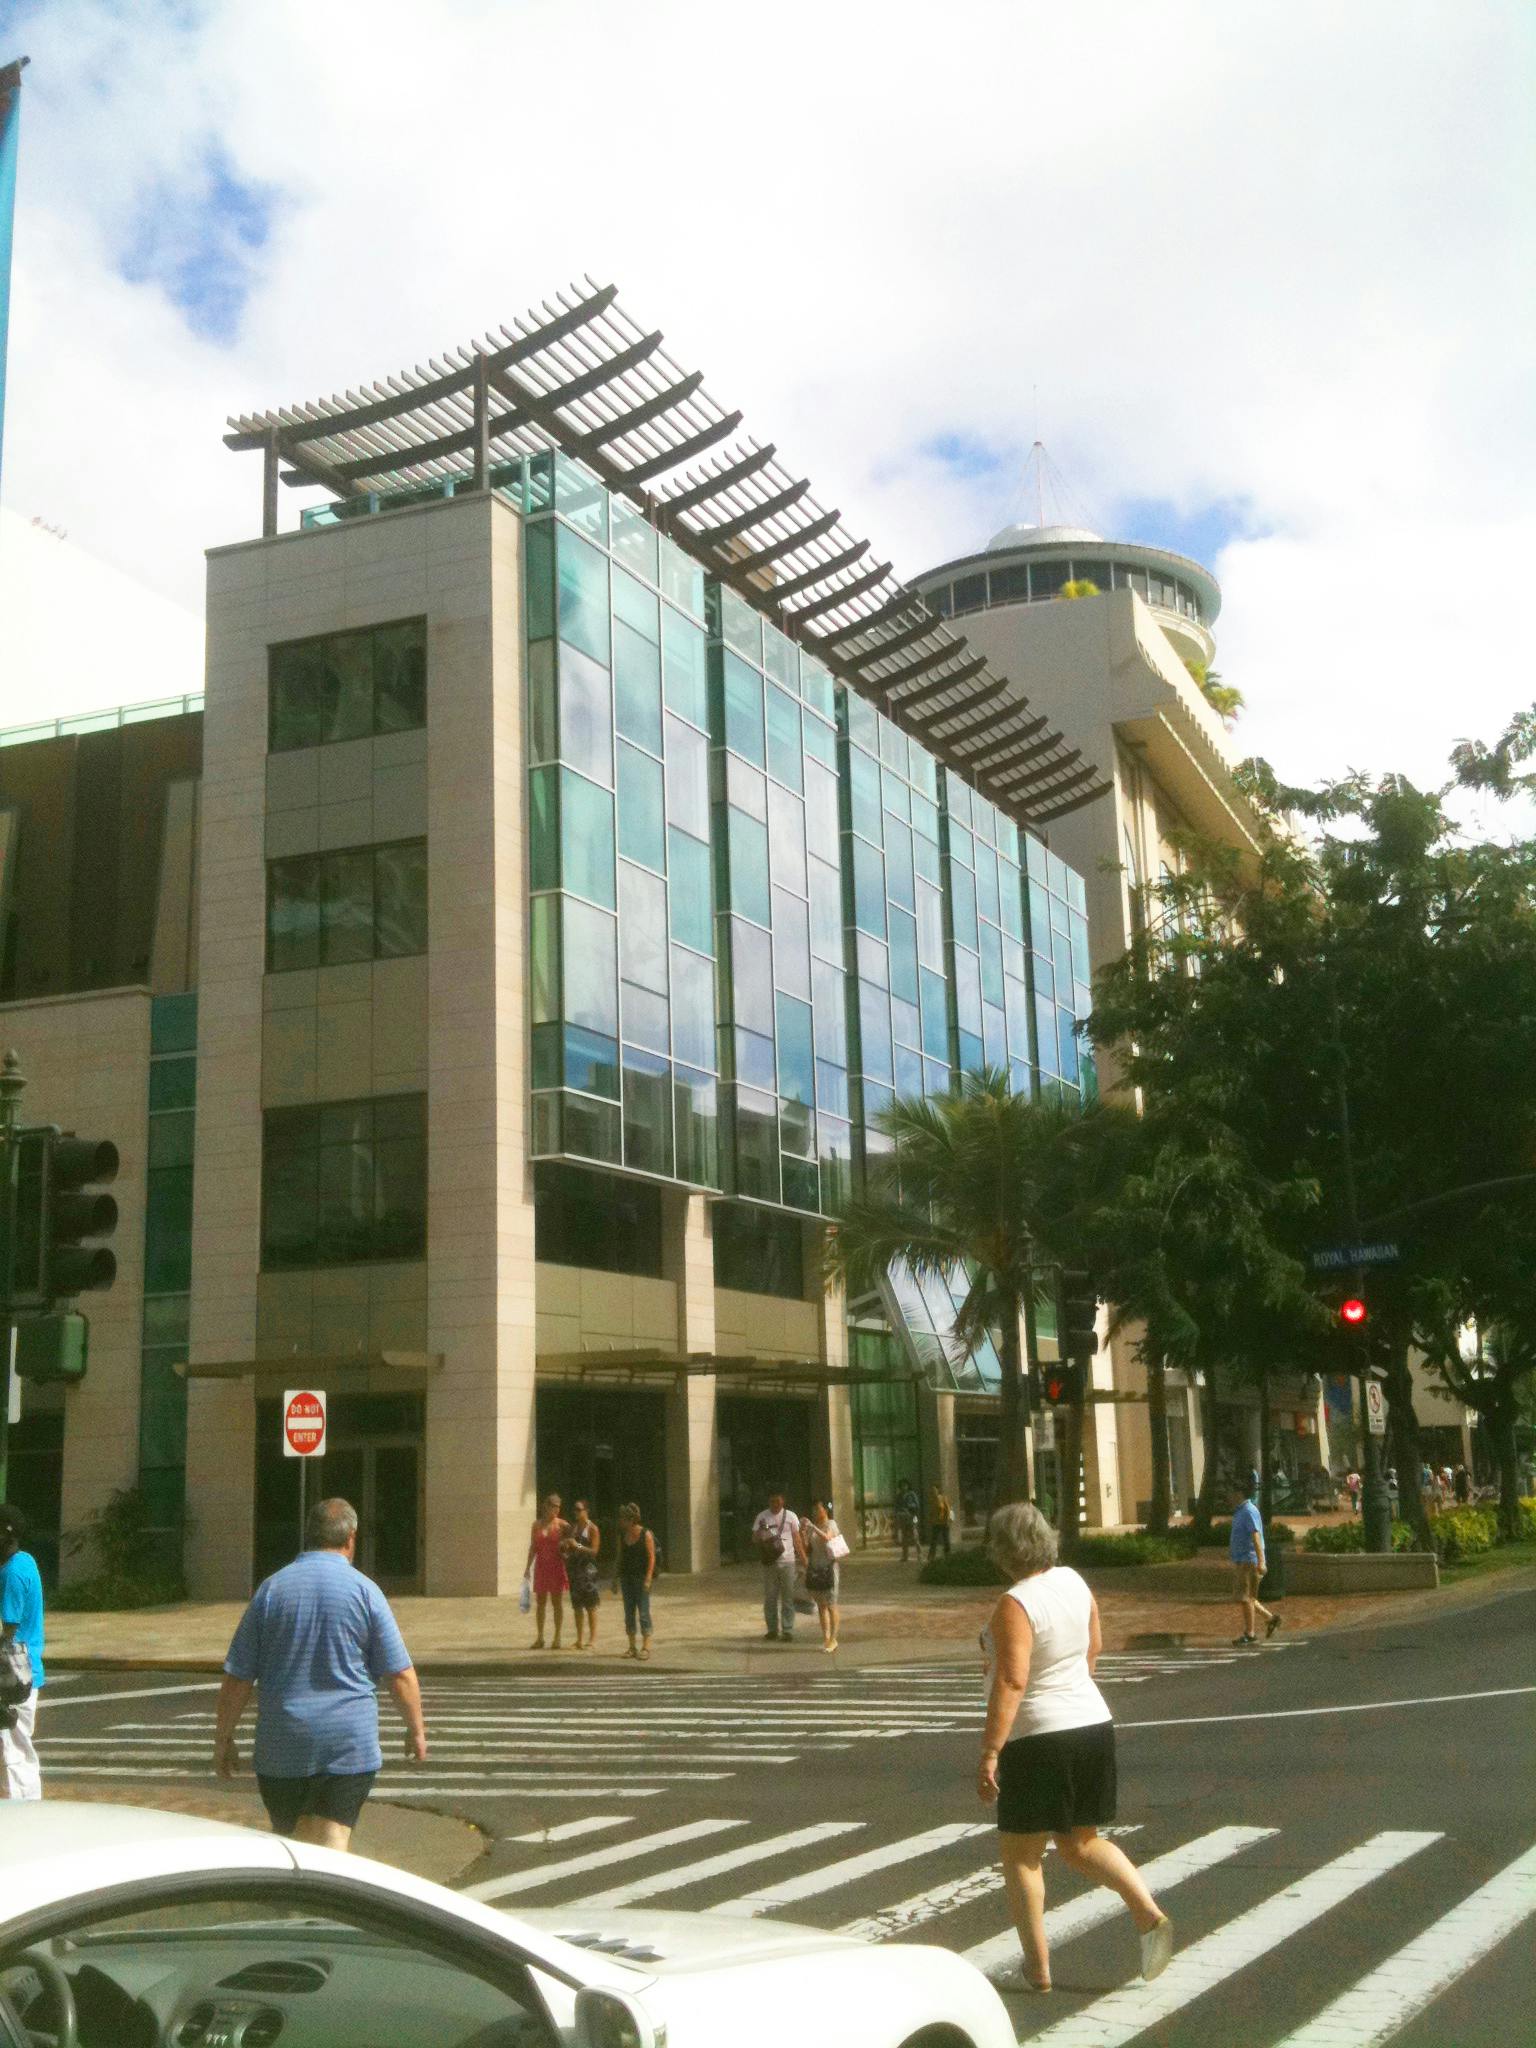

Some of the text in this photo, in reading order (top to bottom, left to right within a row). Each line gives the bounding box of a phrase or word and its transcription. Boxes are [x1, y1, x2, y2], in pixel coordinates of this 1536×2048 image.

[1313, 1244, 1398, 1267] ROYAL HAWAIIAN
[291, 1404, 319, 1415] DO NOT
[293, 1432, 317, 1443] ENTER
